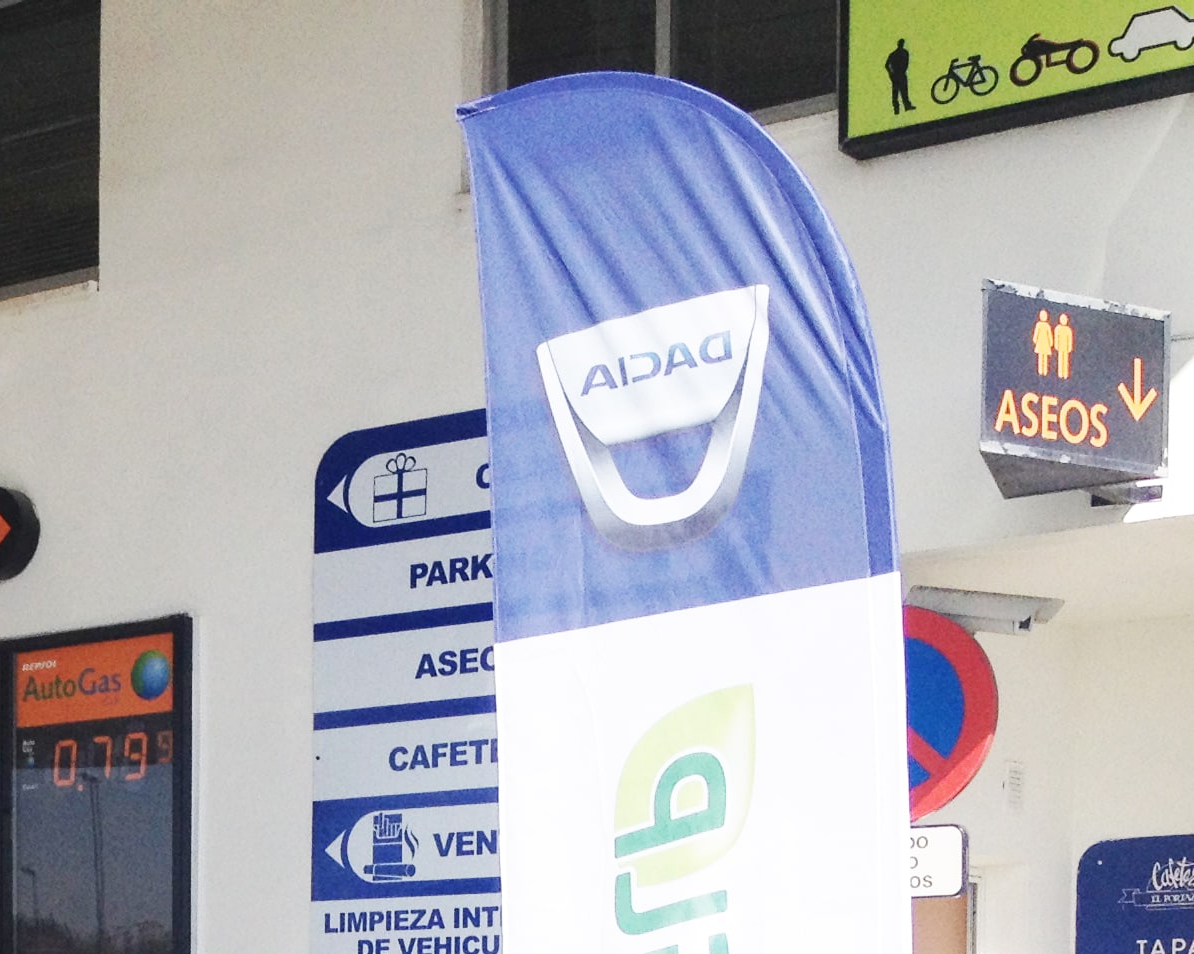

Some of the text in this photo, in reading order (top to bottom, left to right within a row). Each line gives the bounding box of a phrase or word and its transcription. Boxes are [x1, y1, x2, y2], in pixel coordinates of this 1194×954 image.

[994, 389, 1109, 448] ASEOS
[324, 906, 502, 934] LIMPIEZA INT
